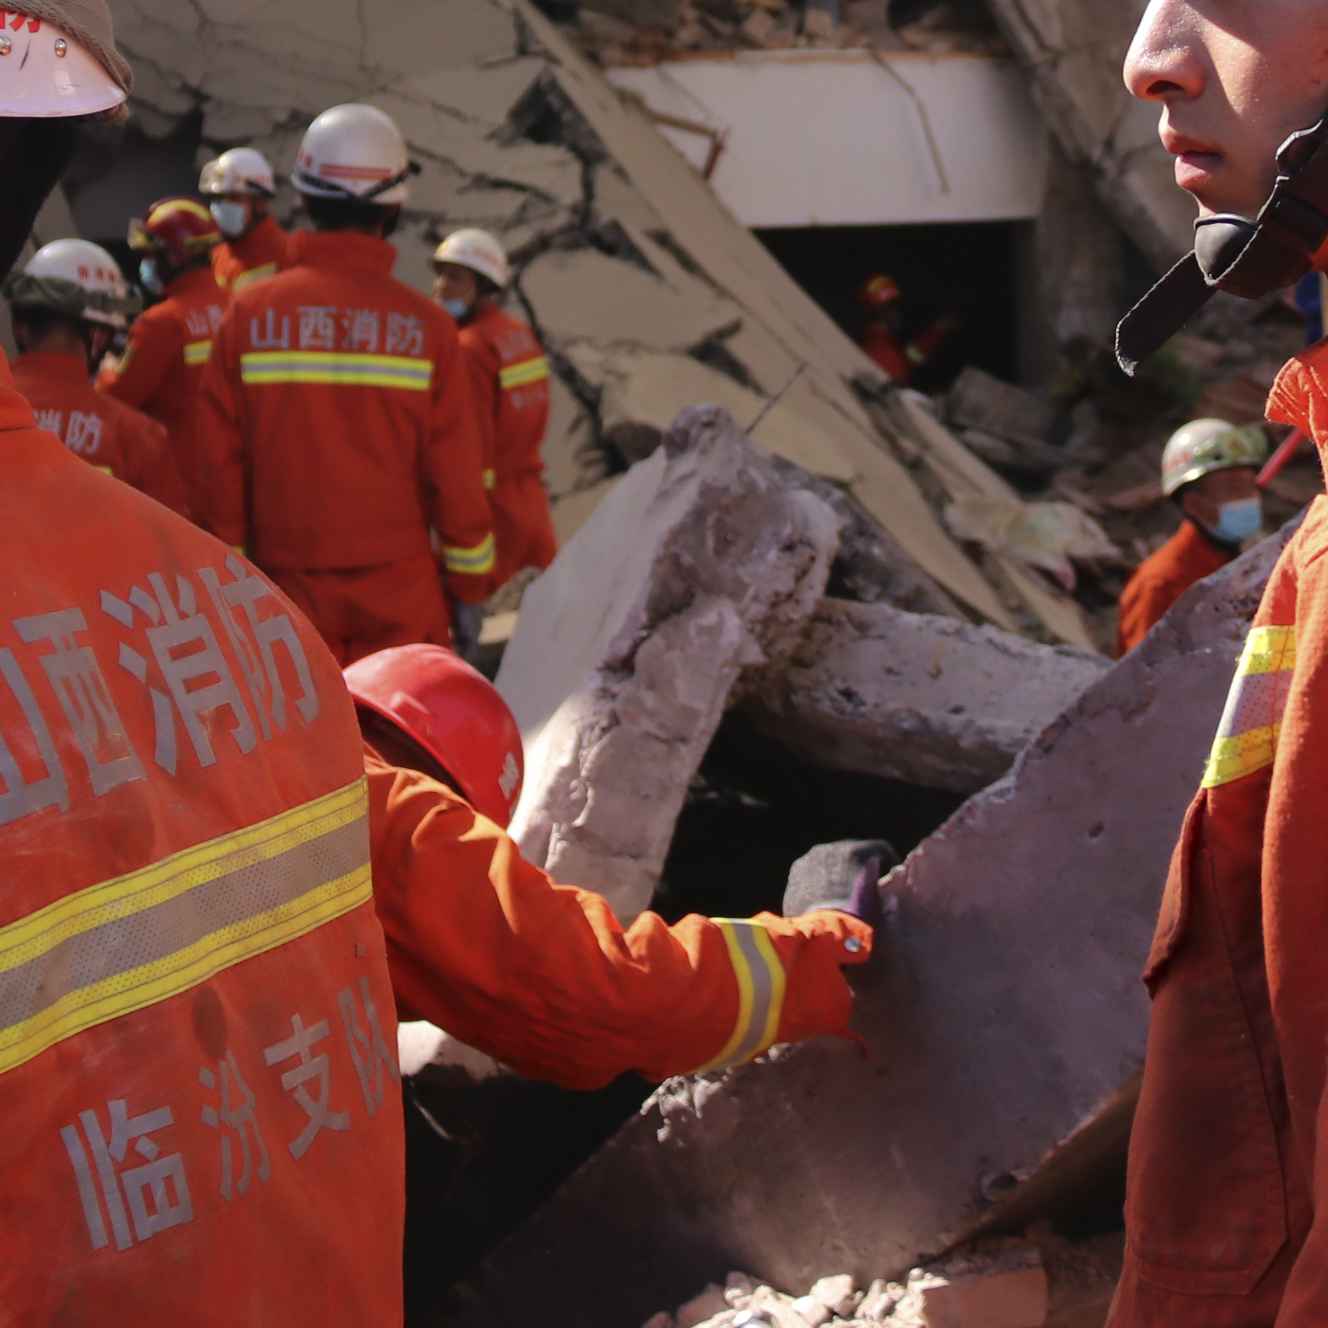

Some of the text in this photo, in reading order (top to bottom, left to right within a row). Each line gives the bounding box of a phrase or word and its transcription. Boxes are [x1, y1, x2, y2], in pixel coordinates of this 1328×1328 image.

[250, 306, 424, 356] 山西消防
[61, 976, 400, 1252] 临汾支队
